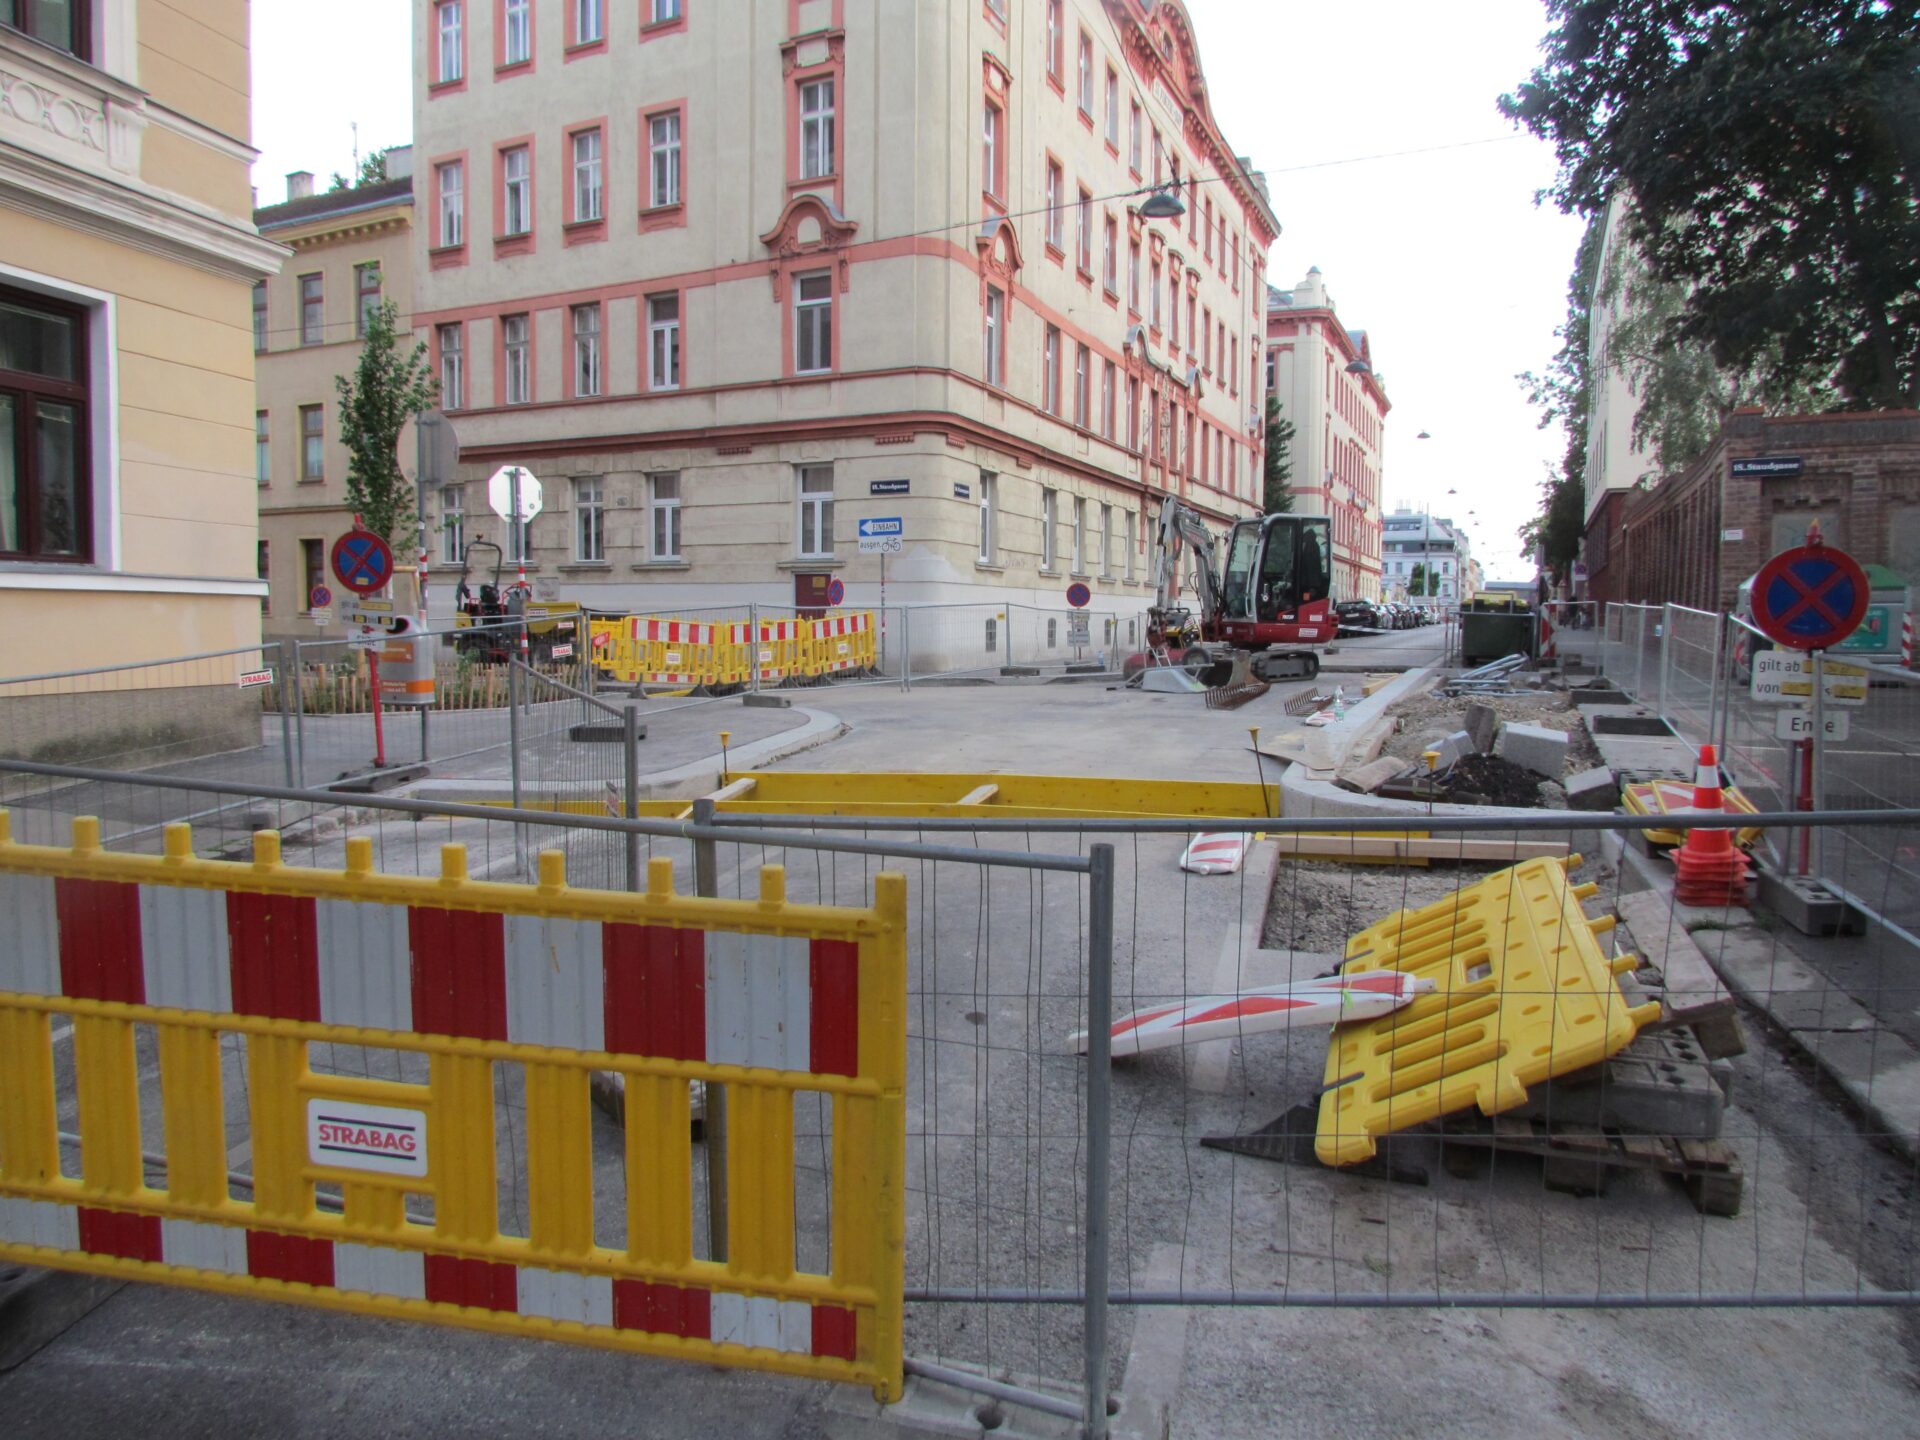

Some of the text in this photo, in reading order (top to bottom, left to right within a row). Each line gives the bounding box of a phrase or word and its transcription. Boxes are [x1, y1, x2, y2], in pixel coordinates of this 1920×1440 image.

[1747, 462, 1799, 471] Staudgasse
[872, 522, 898, 531] EINBAHN
[1759, 658, 1800, 672] gilt ab
[241, 673, 272, 684] STRABAG
[1757, 682, 1779, 693] von
[1791, 717, 1835, 733] Ene
[318, 1123, 416, 1152] STRABAG
